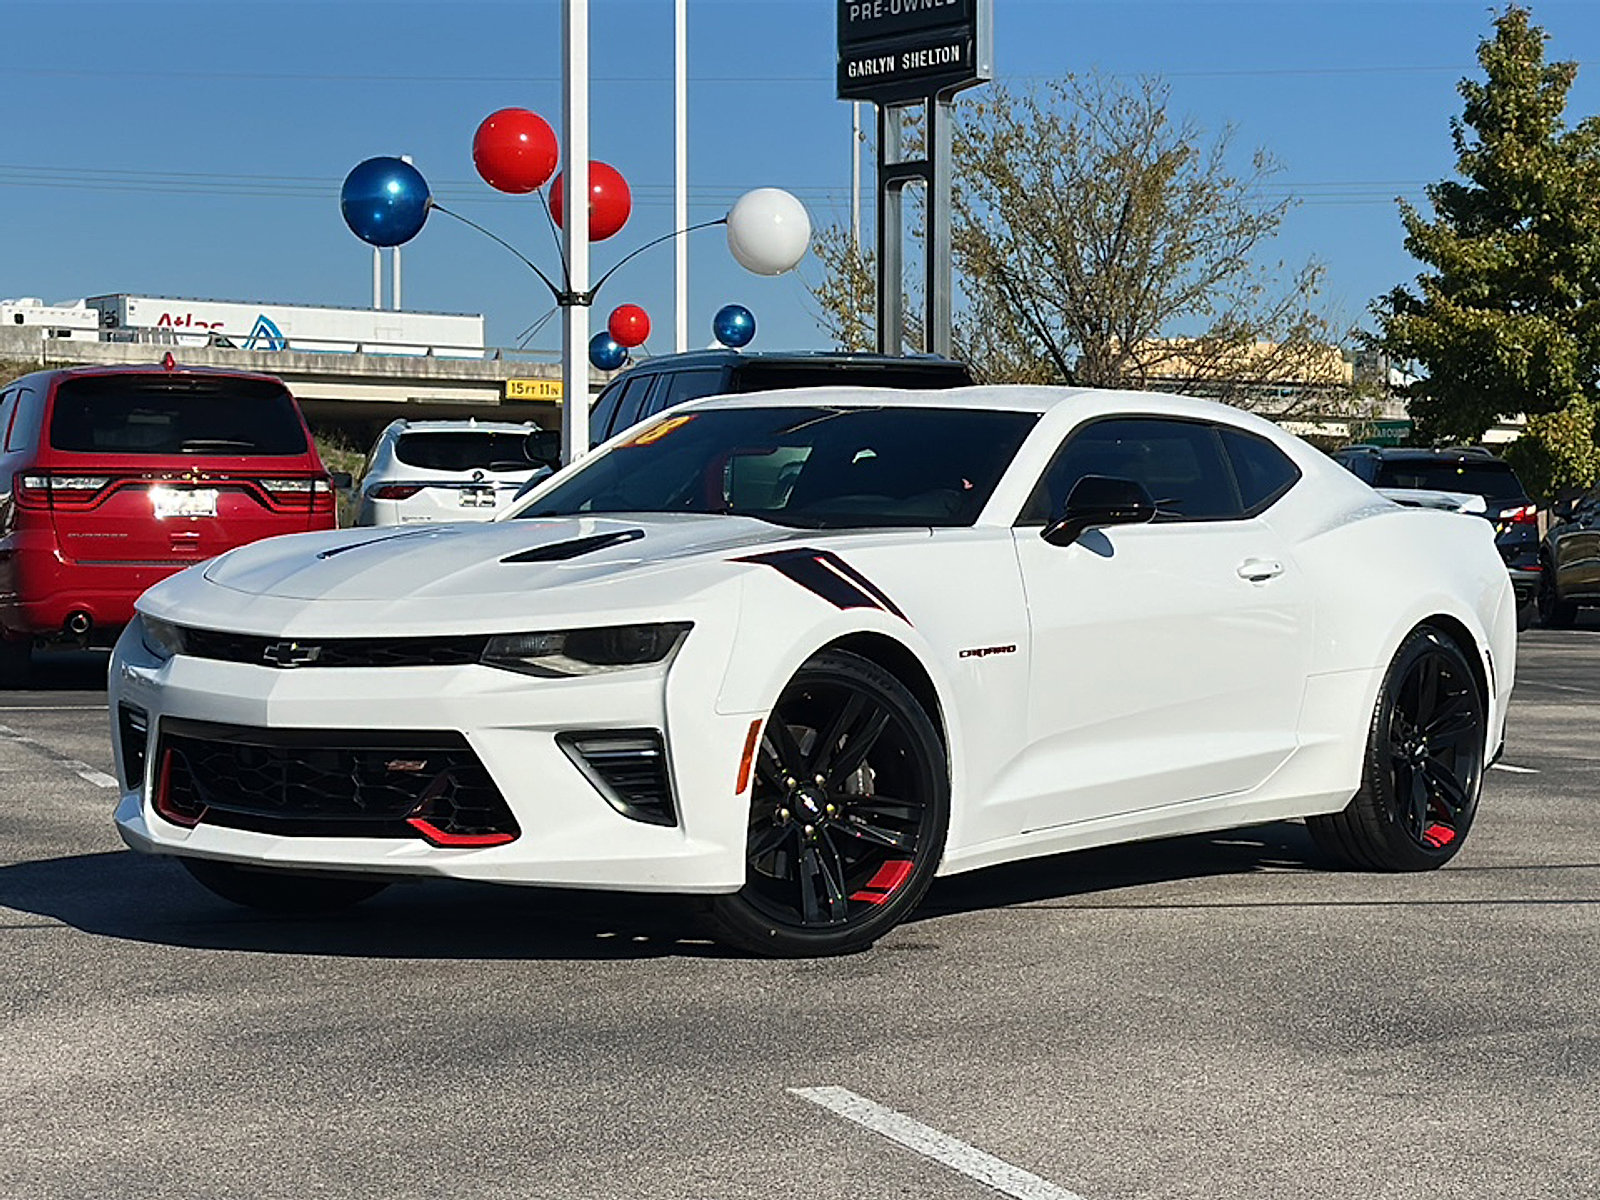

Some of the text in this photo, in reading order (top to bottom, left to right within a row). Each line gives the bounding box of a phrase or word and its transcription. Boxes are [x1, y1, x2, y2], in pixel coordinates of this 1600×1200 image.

[850, 0, 956, 21] PRE-OWN
[848, 45, 960, 77] GARLYN SHELTON
[157, 313, 224, 329] Atl
